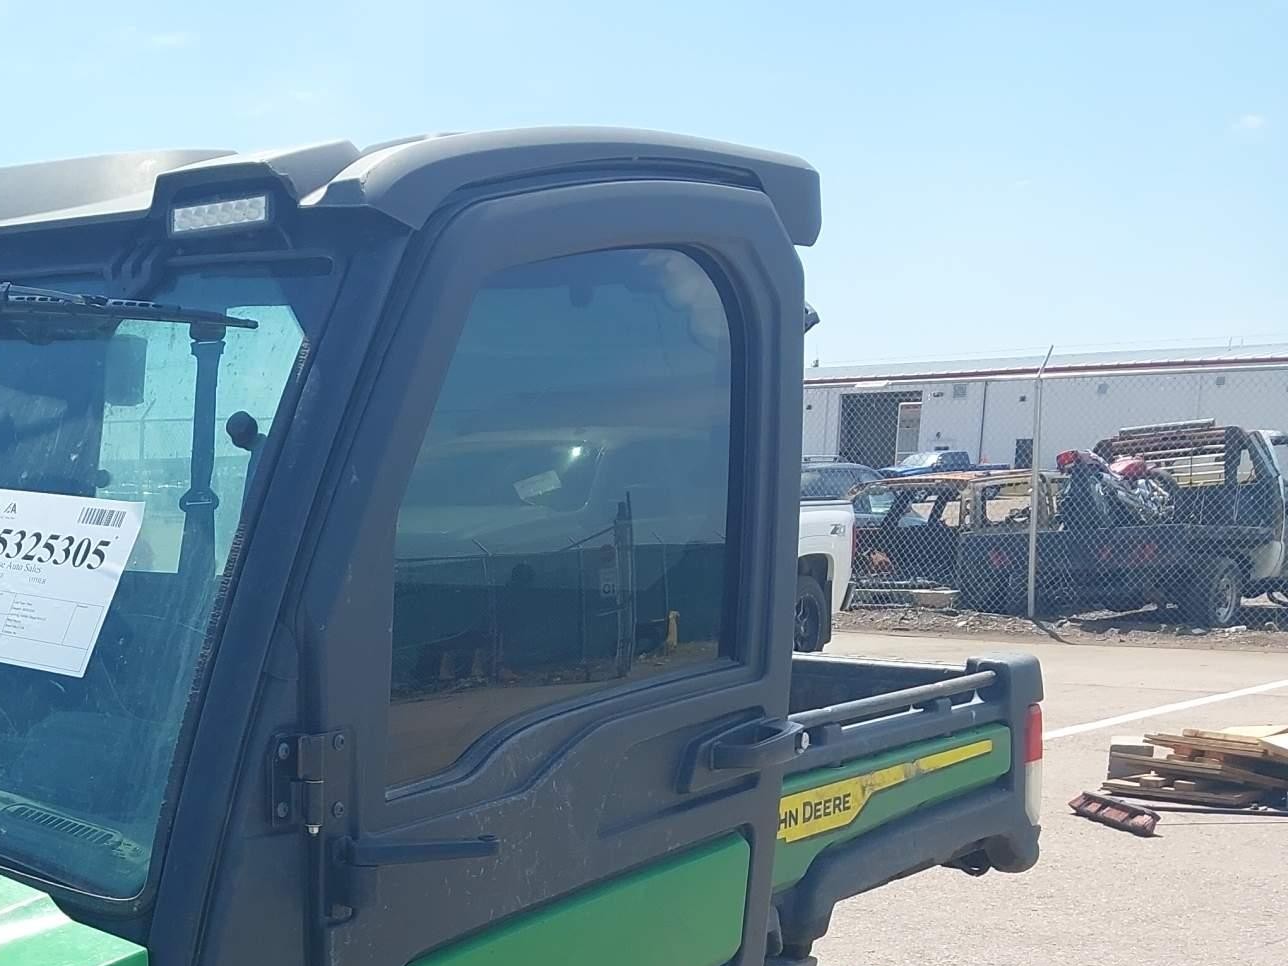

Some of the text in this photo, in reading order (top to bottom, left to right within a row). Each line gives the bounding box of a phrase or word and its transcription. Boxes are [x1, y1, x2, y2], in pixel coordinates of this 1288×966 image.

[6, 561, 23, 571] Auto
[24, 563, 42, 574] Sales
[778, 793, 852, 831] HN DEERE
